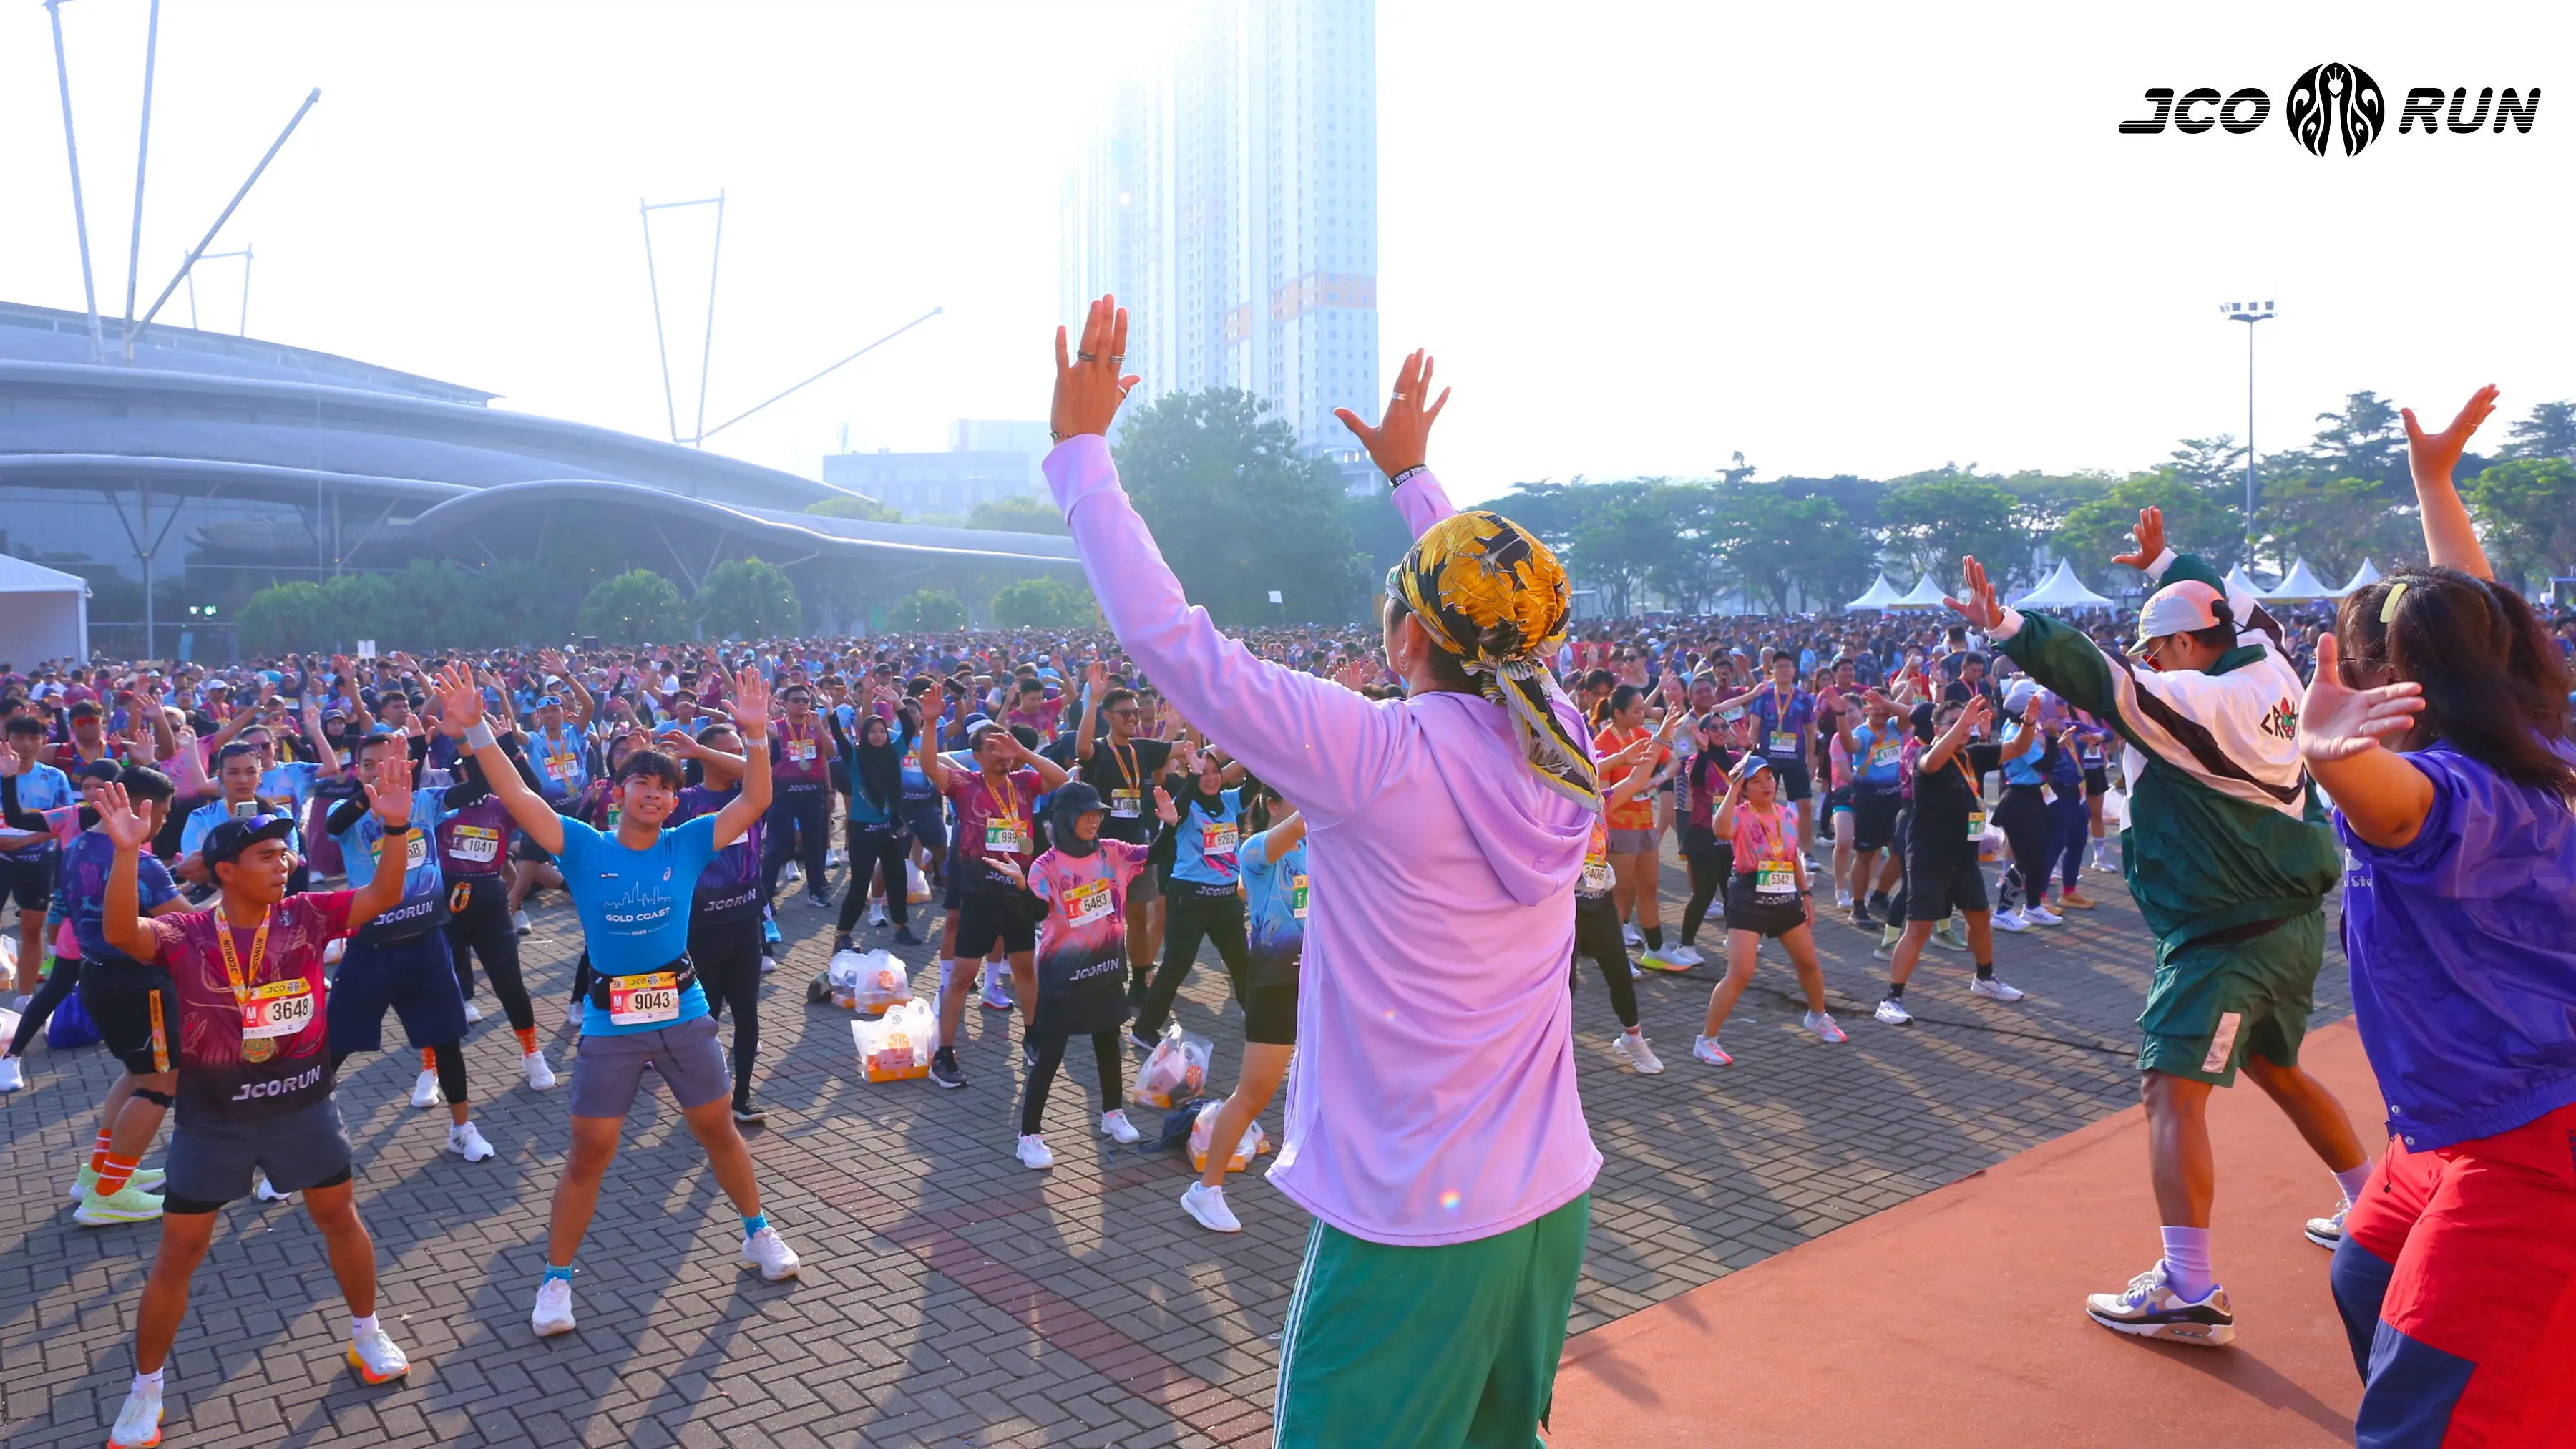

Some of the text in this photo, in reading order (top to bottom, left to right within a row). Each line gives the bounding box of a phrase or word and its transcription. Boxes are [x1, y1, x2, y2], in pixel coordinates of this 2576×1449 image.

[469, 839, 492, 853] 1041
[1217, 833, 1234, 845] 6282
[1585, 867, 1604, 881] 2406
[1771, 874, 1790, 885] 5342
[1196, 886, 1236, 896] JCORUN
[704, 888, 756, 912] JCORUN
[1083, 893, 1107, 912] 5483
[373, 901, 434, 925] JCORUN
[606, 907, 671, 922] GOLD COAST
[223, 940, 239, 974] JCORUN
[251, 937, 264, 971] JCORUN
[1069, 958, 1120, 981] JCORUN
[266, 985, 286, 994] JCO
[273, 997, 308, 1021] 3648
[613, 995, 622, 1007] M
[635, 992, 670, 1010] 9043
[246, 1006, 257, 1020] M
[231, 1065, 321, 1101] JCORUN
